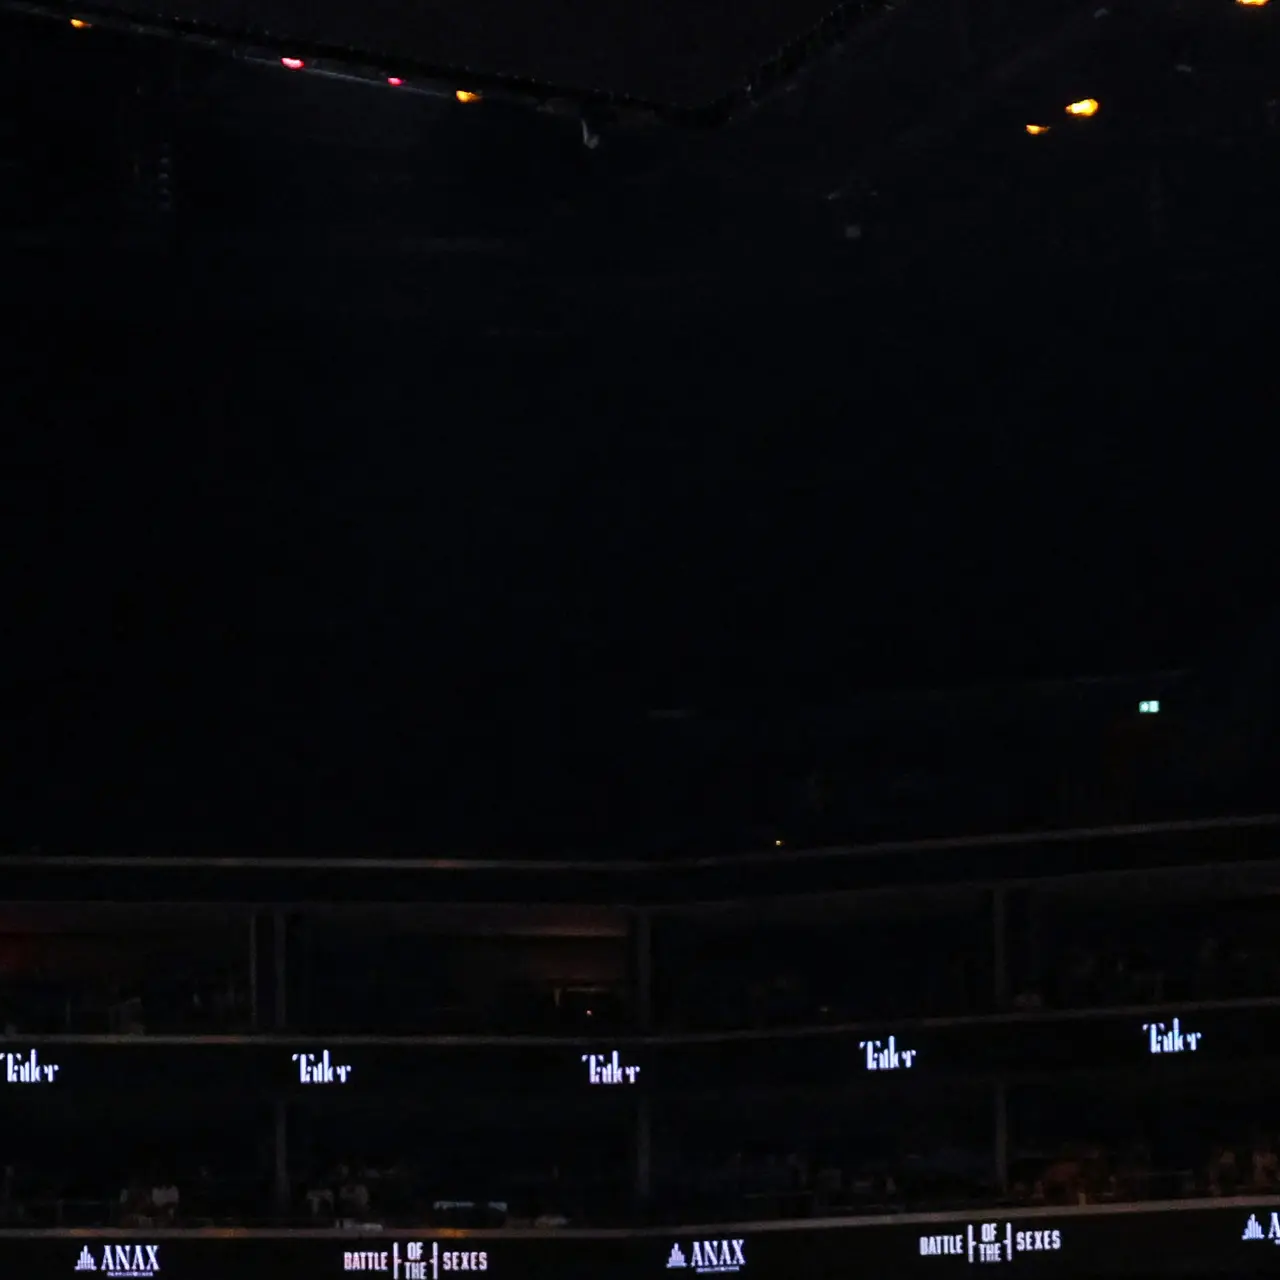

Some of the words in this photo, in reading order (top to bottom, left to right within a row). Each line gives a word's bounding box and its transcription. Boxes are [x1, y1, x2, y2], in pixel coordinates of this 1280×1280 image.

[1143, 1018, 1201, 1053] Tatler
[860, 1036, 916, 1070] Tatler
[0, 1049, 59, 1082] Tatler
[292, 1050, 351, 1083] Tatler
[582, 1051, 640, 1084] Tatler
[980, 1223, 998, 1242] OF
[1015, 1230, 1061, 1252] SEXES
[406, 1241, 424, 1260] OF
[689, 1239, 746, 1268] ANAX
[919, 1234, 964, 1256] BATTLE
[978, 1242, 1001, 1263] THE
[99, 1244, 160, 1272] ANAX
[343, 1251, 389, 1271] BATTLE
[442, 1251, 488, 1271] SEXES
[403, 1260, 428, 1280] THE
